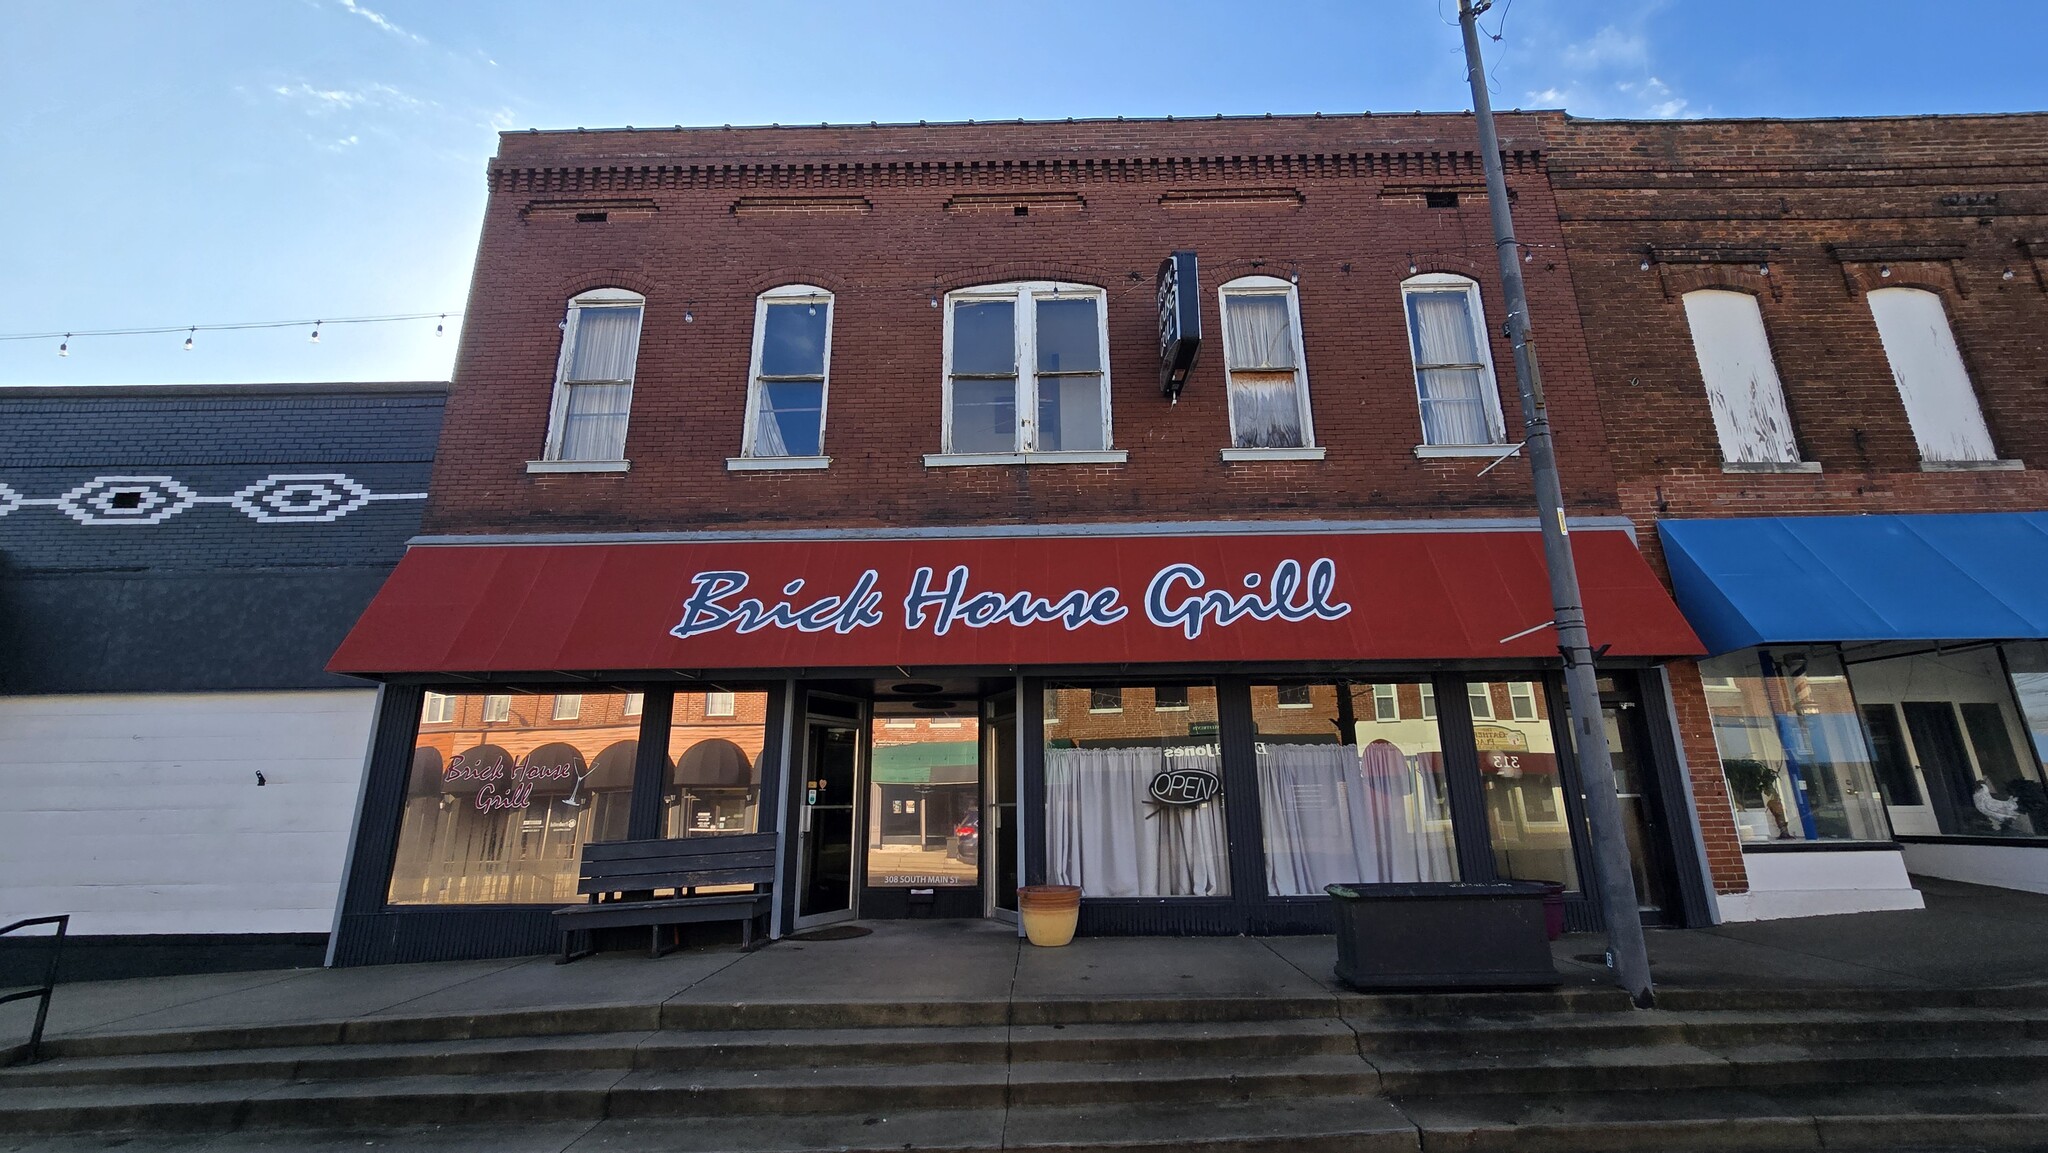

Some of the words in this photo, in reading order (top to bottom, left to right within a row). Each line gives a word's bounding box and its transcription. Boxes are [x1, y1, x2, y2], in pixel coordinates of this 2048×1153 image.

[669, 569, 883, 638] Brick
[903, 565, 1128, 635] House
[1144, 558, 1351, 639] Grill
[444, 755, 504, 782] Brick
[511, 754, 571, 781] House
[475, 782, 534, 814] Grill
[1154, 773, 1214, 800] OPEN
[884, 875, 898, 884] 308
[899, 875, 927, 884] SOUTH
[927, 875, 949, 884] MAIN
[949, 875, 959, 884] ST
